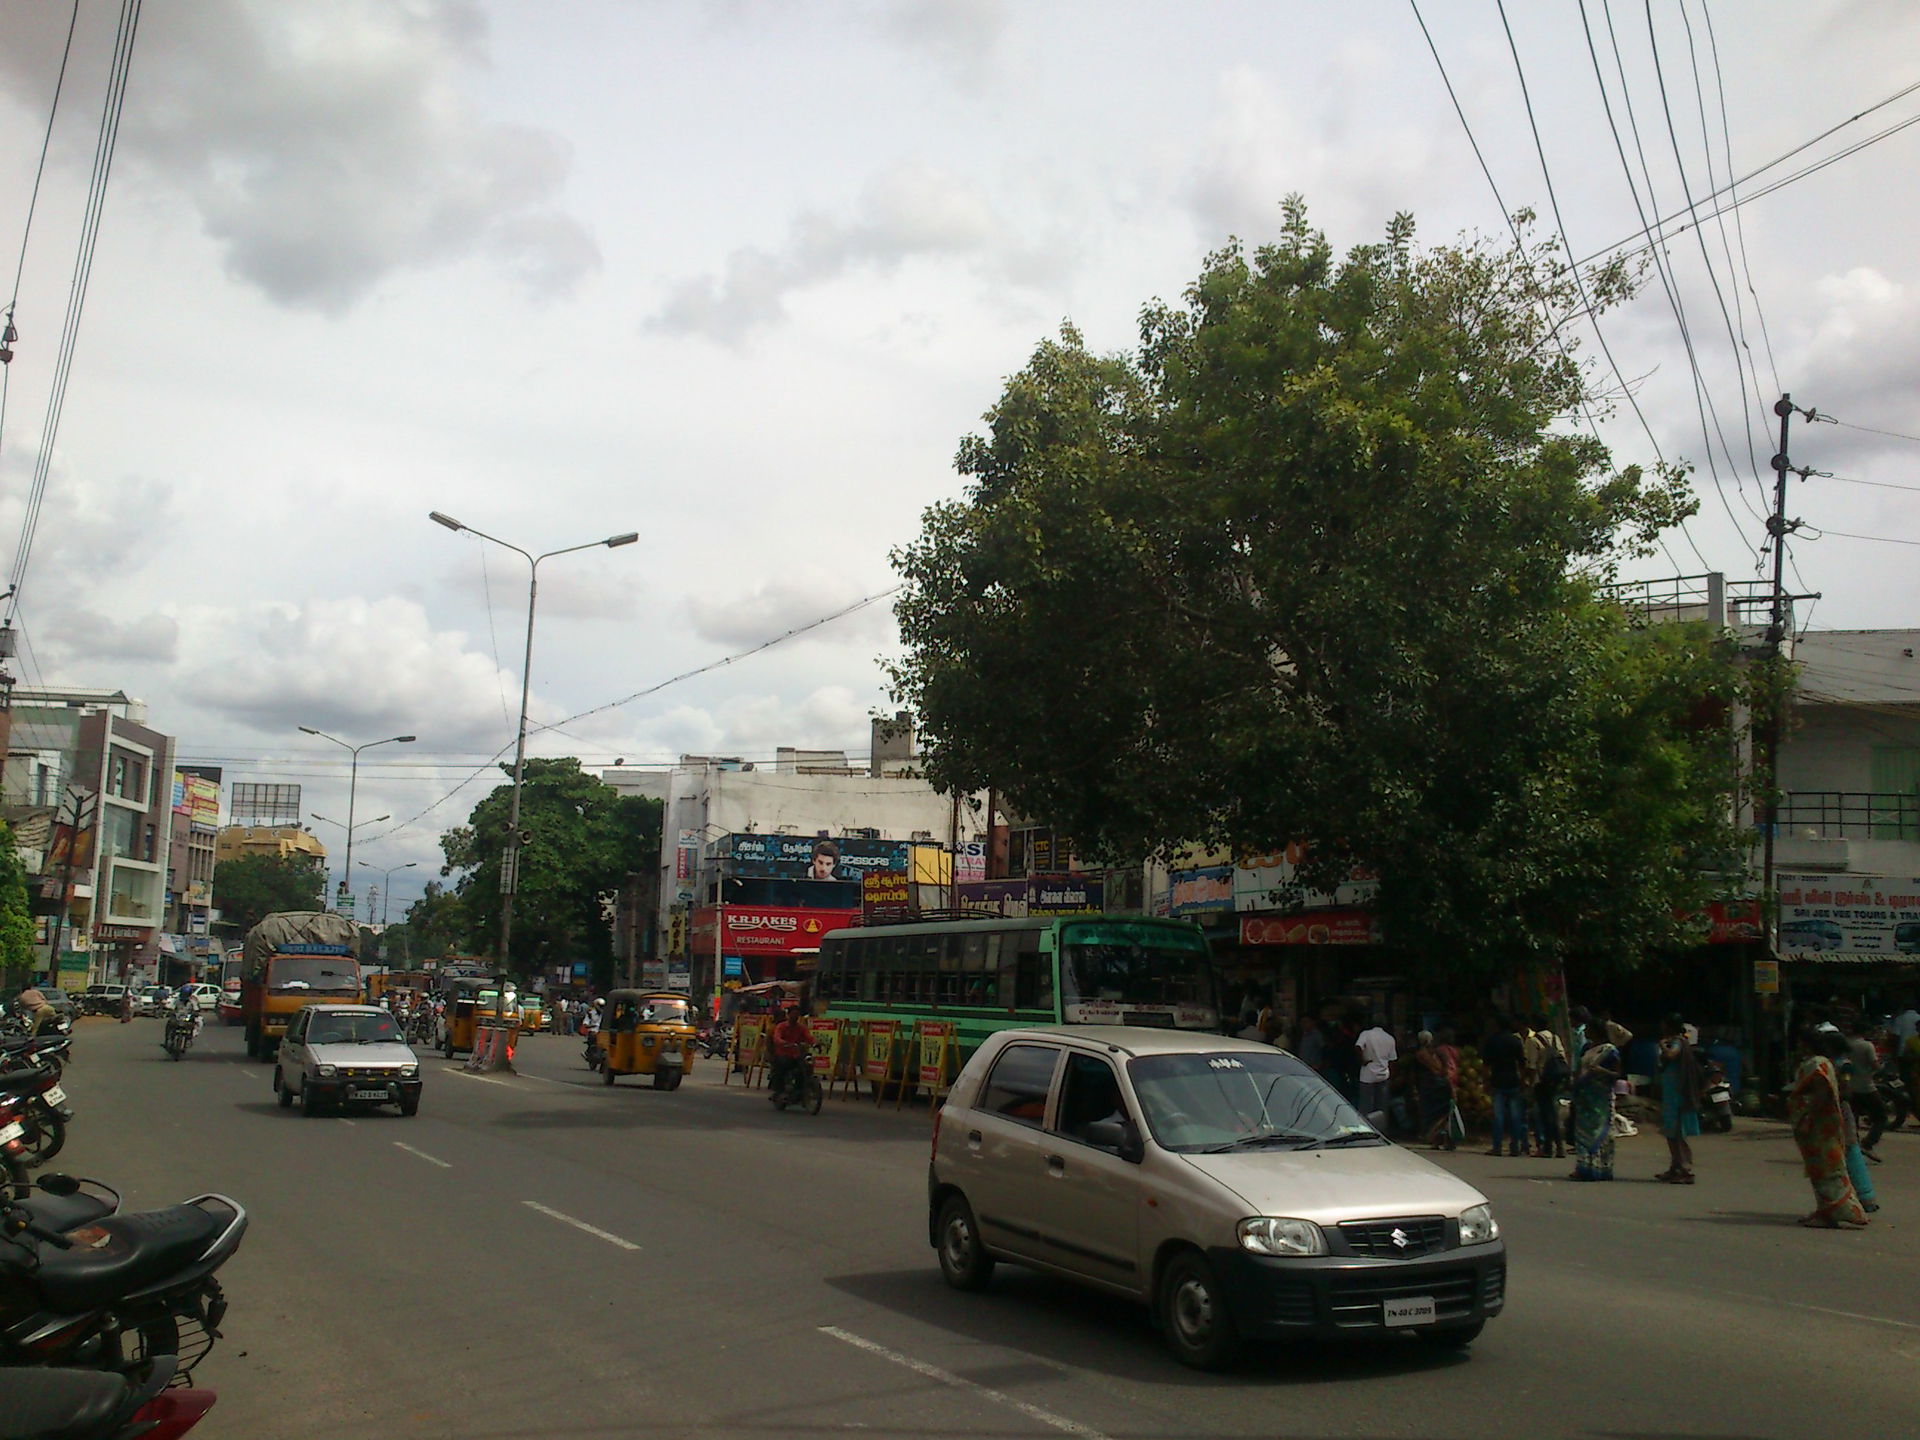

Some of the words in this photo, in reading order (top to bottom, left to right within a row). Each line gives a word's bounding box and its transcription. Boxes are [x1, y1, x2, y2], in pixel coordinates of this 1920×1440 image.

[840, 855, 889, 866] SCISSORS
[1874, 891, 1885, 905] &
[1794, 909, 1809, 917] SRI
[1813, 909, 1830, 918] JEE
[1833, 910, 1850, 918] VEE
[1854, 910, 1887, 919] TOURS
[1889, 911, 1896, 919] &
[736, 936, 785, 945] RESTAURANT
